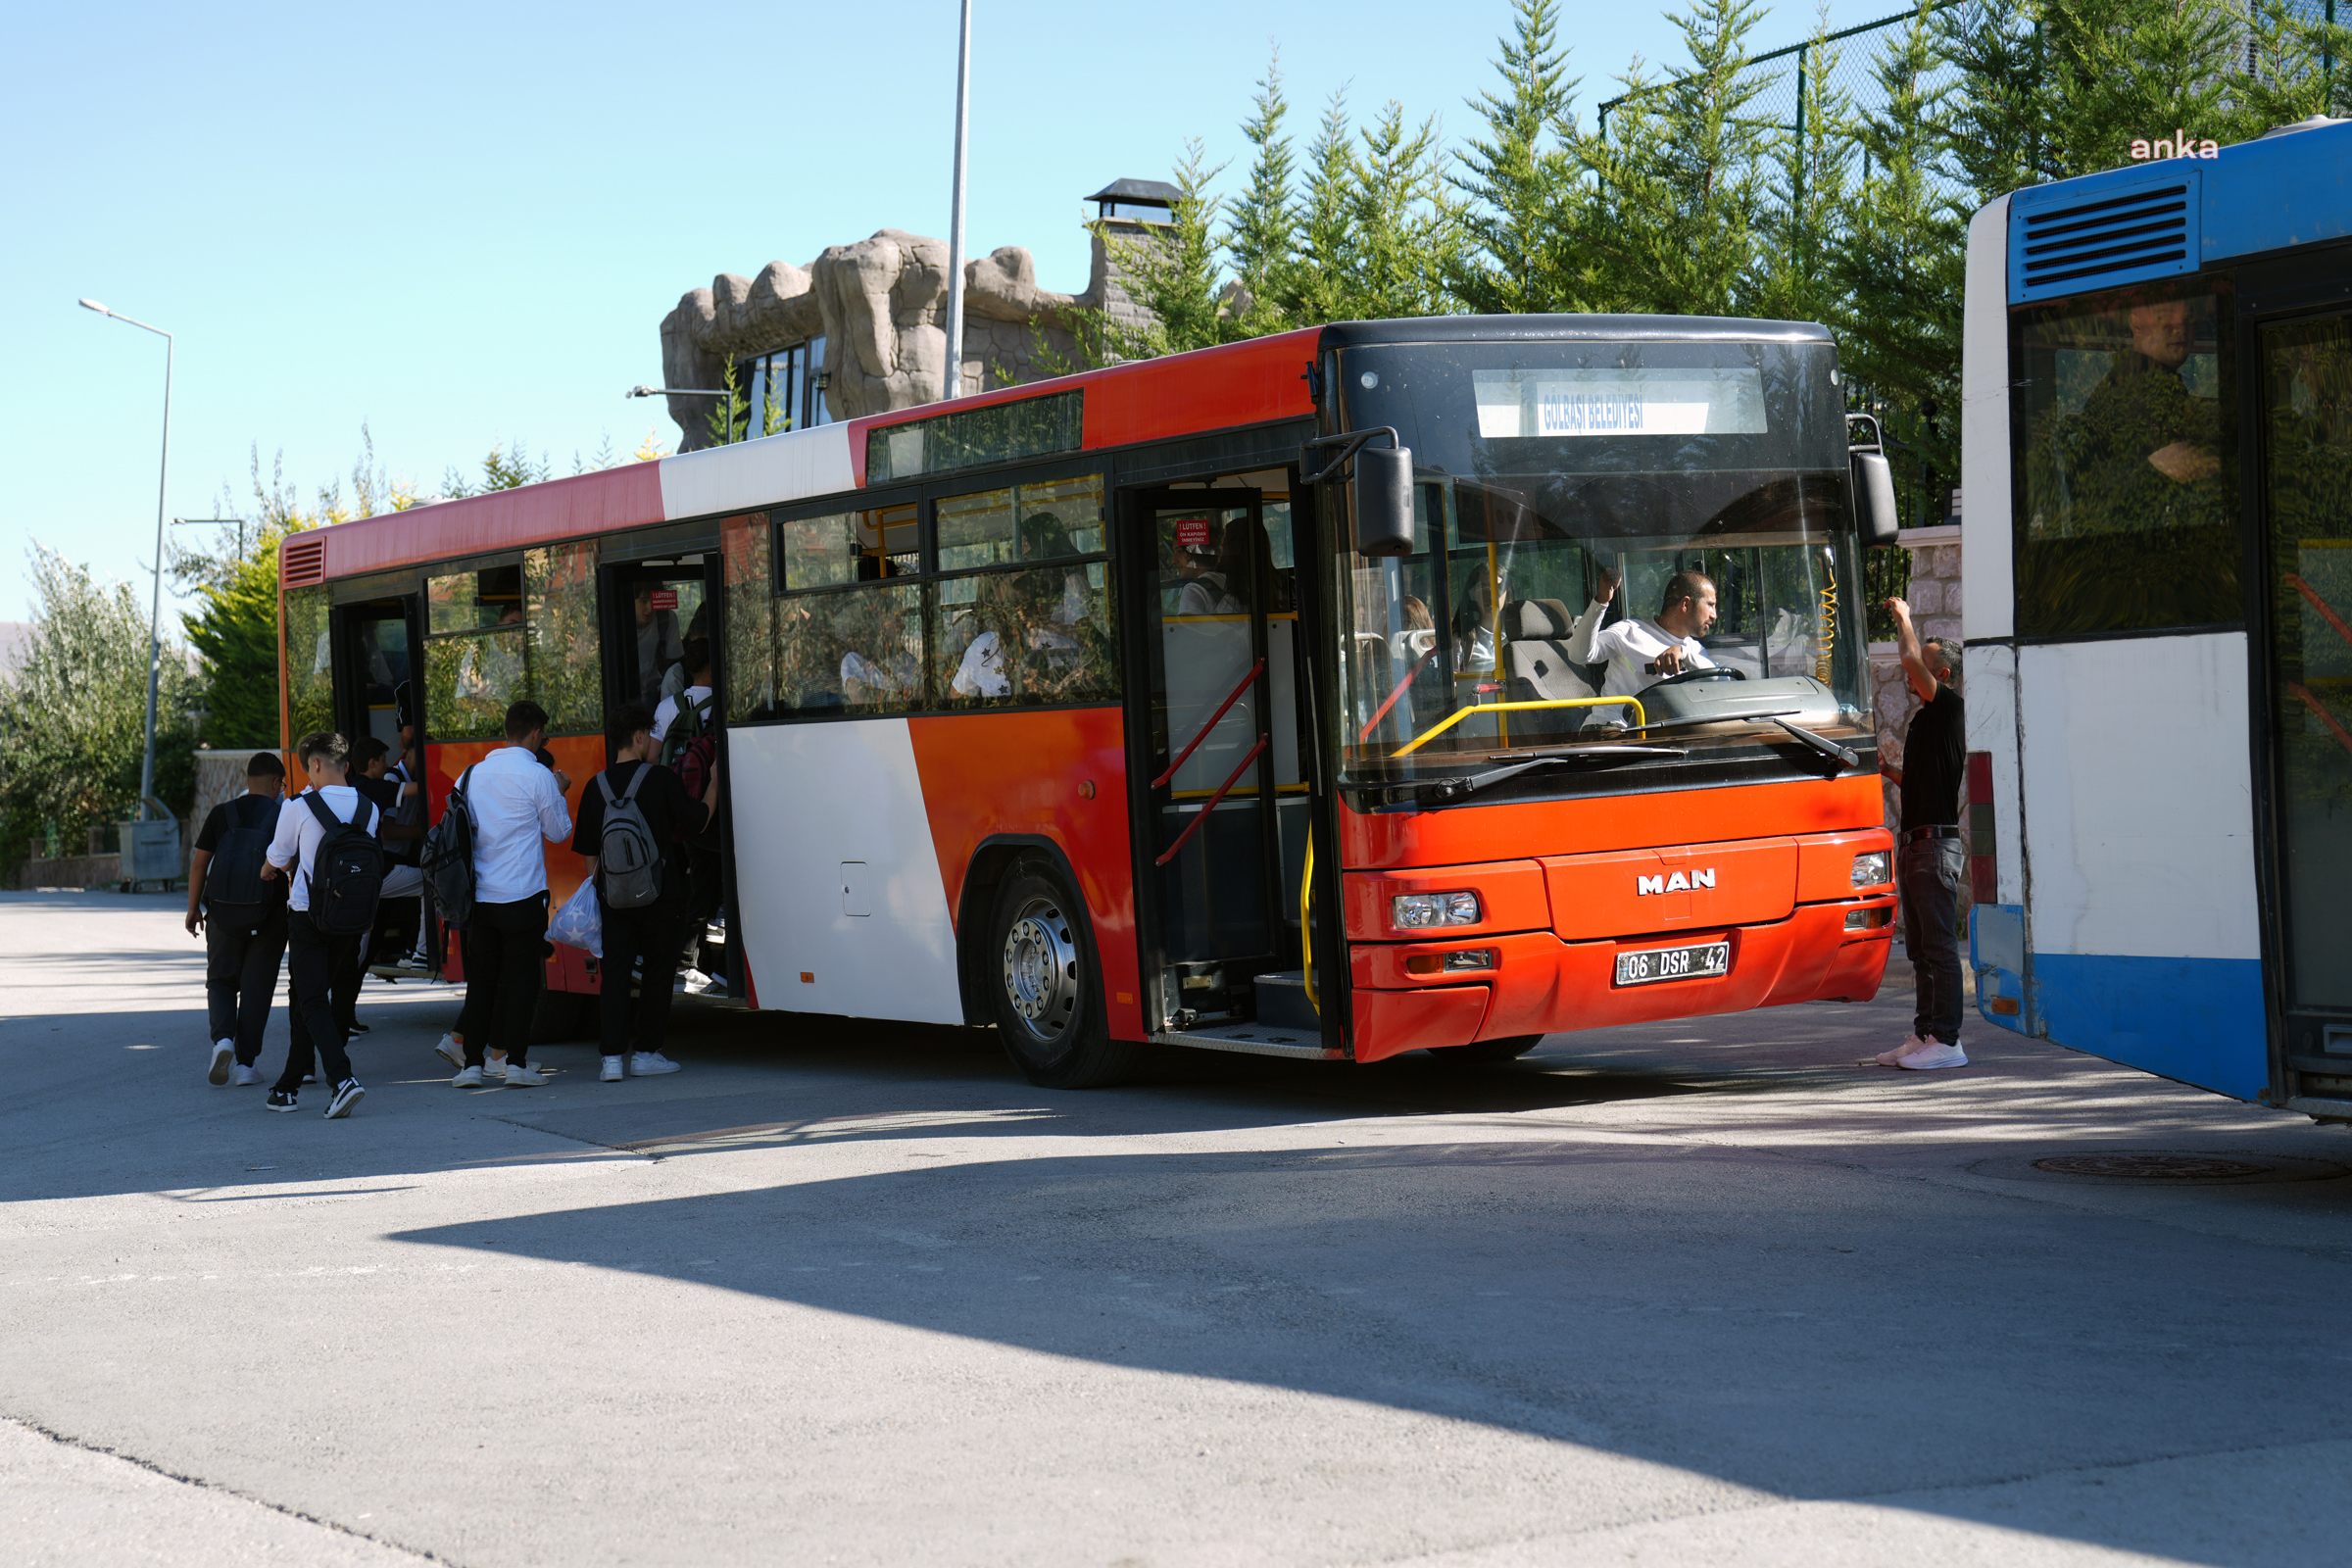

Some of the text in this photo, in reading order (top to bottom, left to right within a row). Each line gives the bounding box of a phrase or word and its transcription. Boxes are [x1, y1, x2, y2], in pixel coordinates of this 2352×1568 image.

[1544, 384, 1643, 436] GÖLBAŞI BELEDİYESİ
[1182, 521, 1203, 530] LÜTFEN
[1637, 868, 1716, 896] MAN
[1628, 946, 1726, 979] 06 DSR 42
